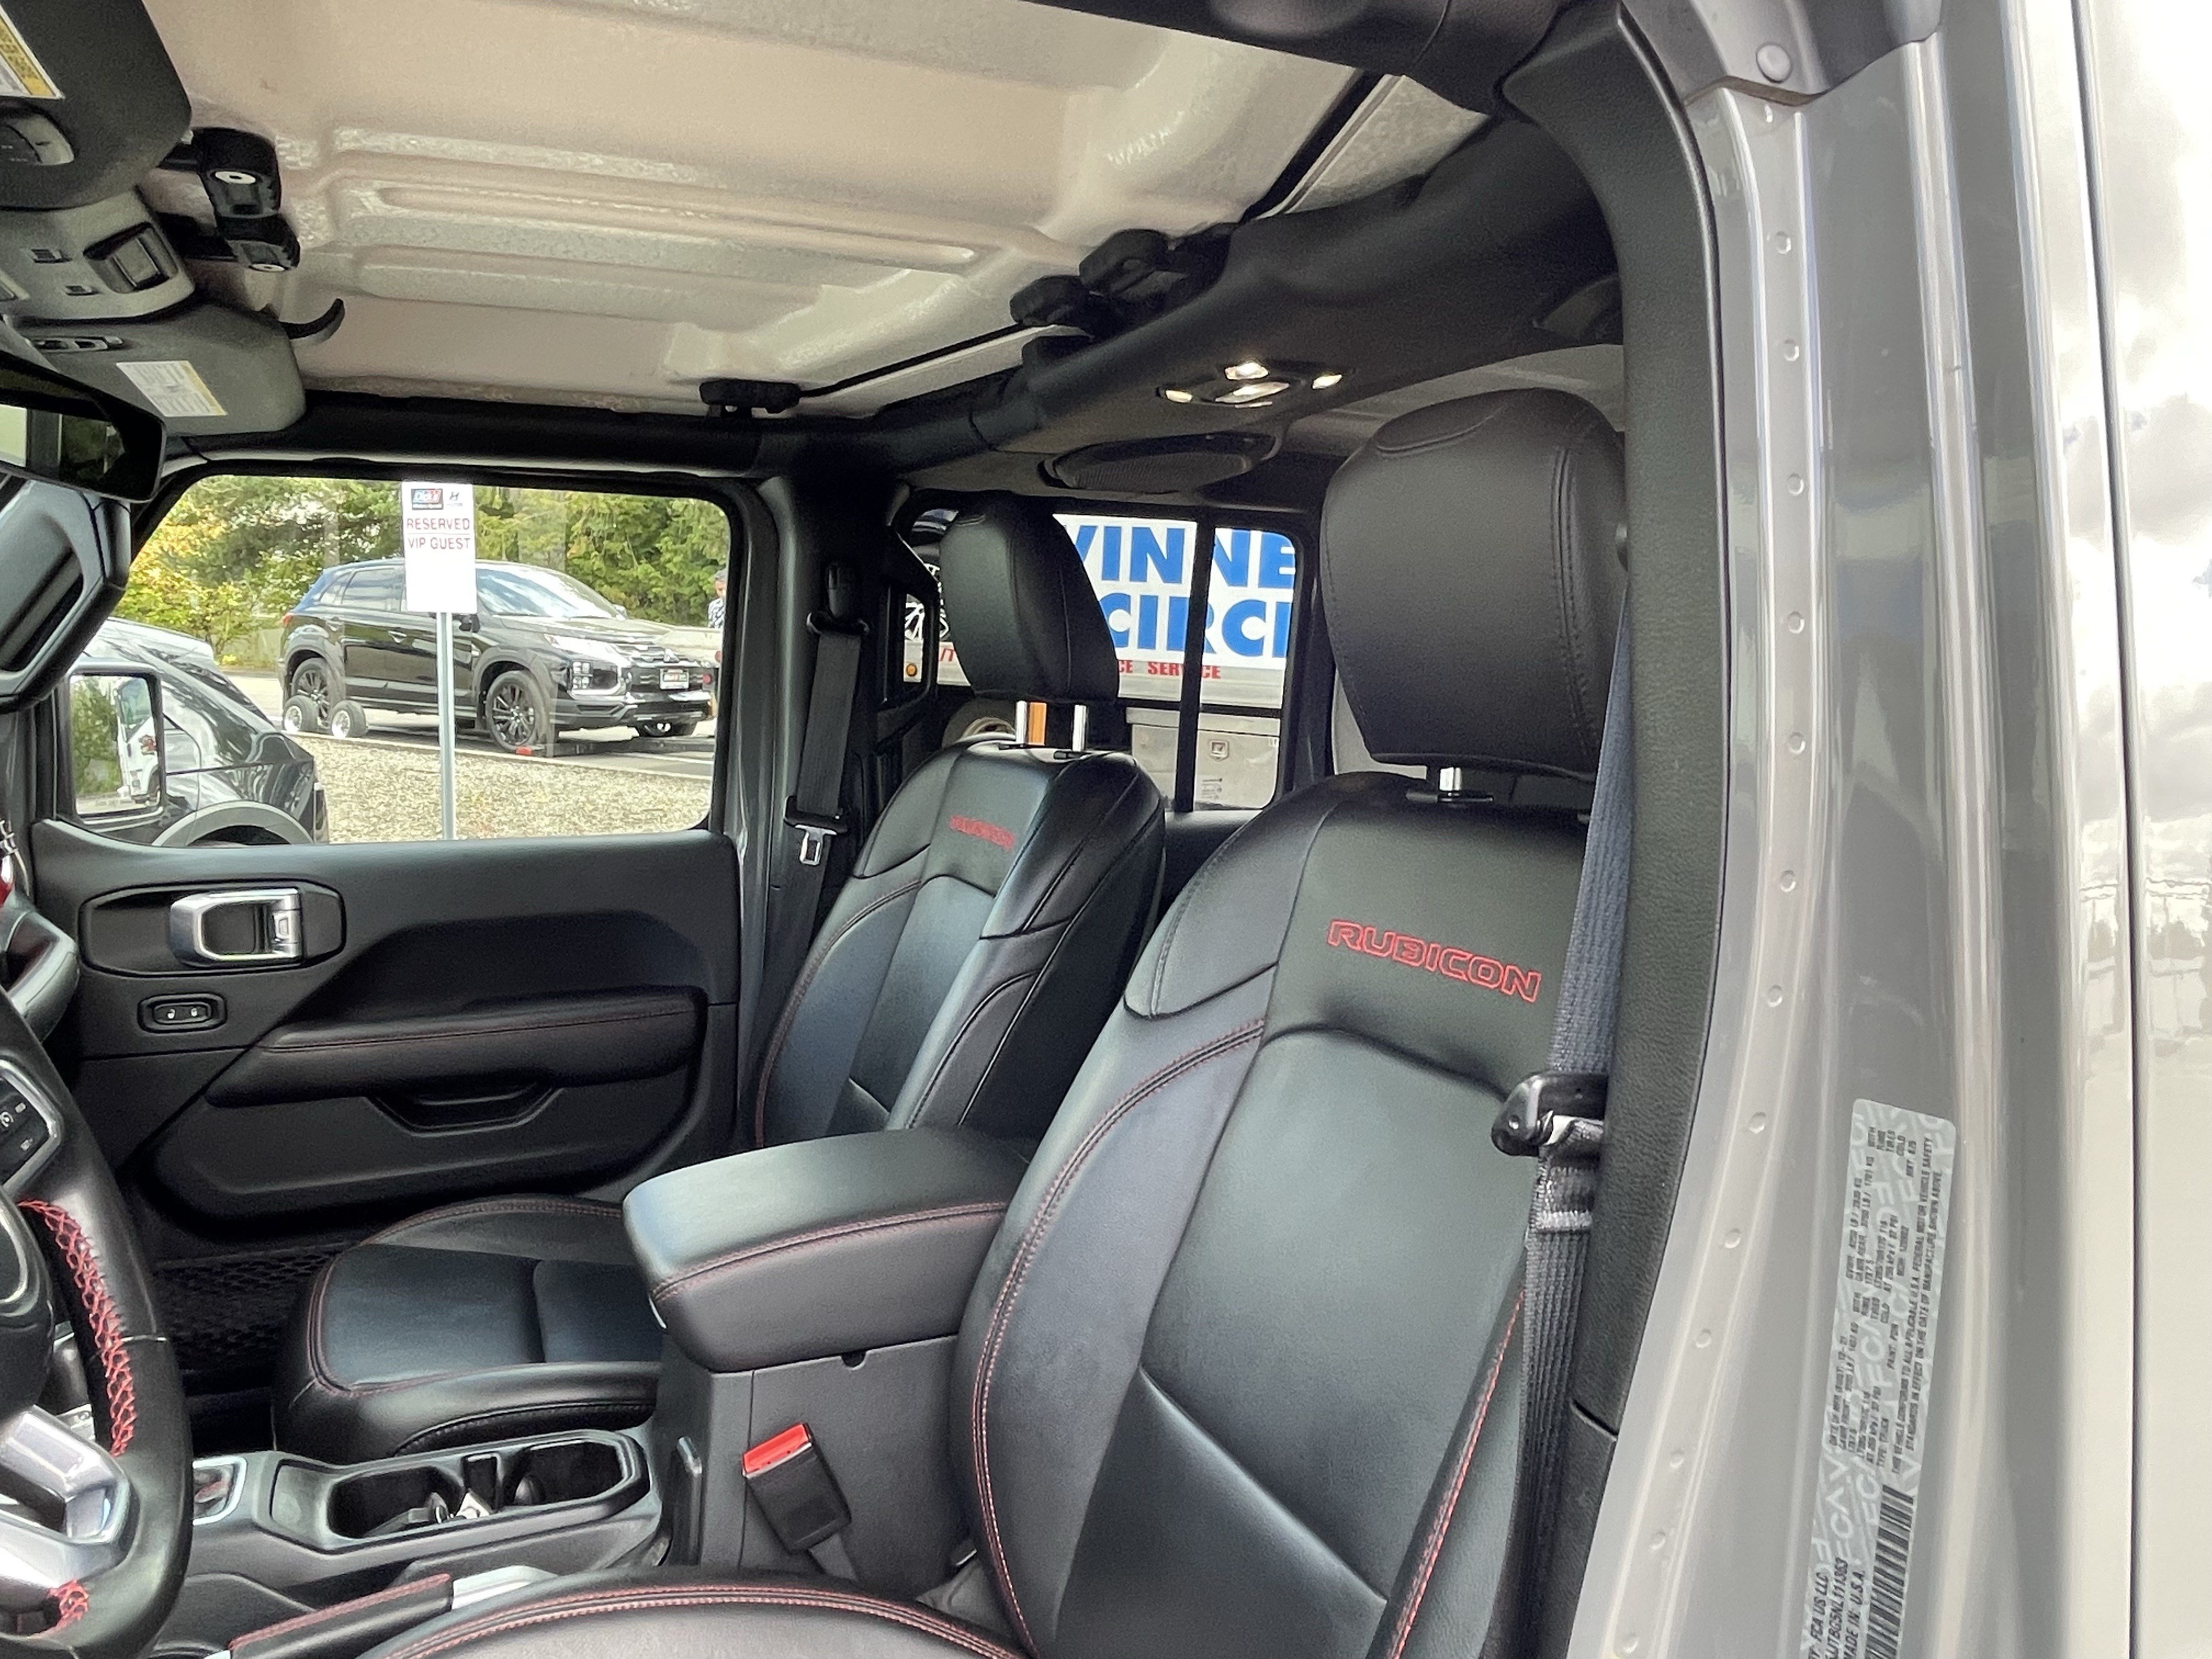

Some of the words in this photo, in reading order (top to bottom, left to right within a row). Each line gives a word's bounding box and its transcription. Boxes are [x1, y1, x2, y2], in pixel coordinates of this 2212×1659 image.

[407, 518, 470, 530] RESERVED
[409, 537, 426, 550] VIP
[430, 537, 471, 550] GUEST
[1148, 662, 1222, 679] SERCE
[1327, 919, 1542, 1003] RUBICON
[1815, 1572, 1829, 1596] LLC
[1813, 1596, 1826, 1616] US
[1810, 1617, 1824, 1642] FCA
